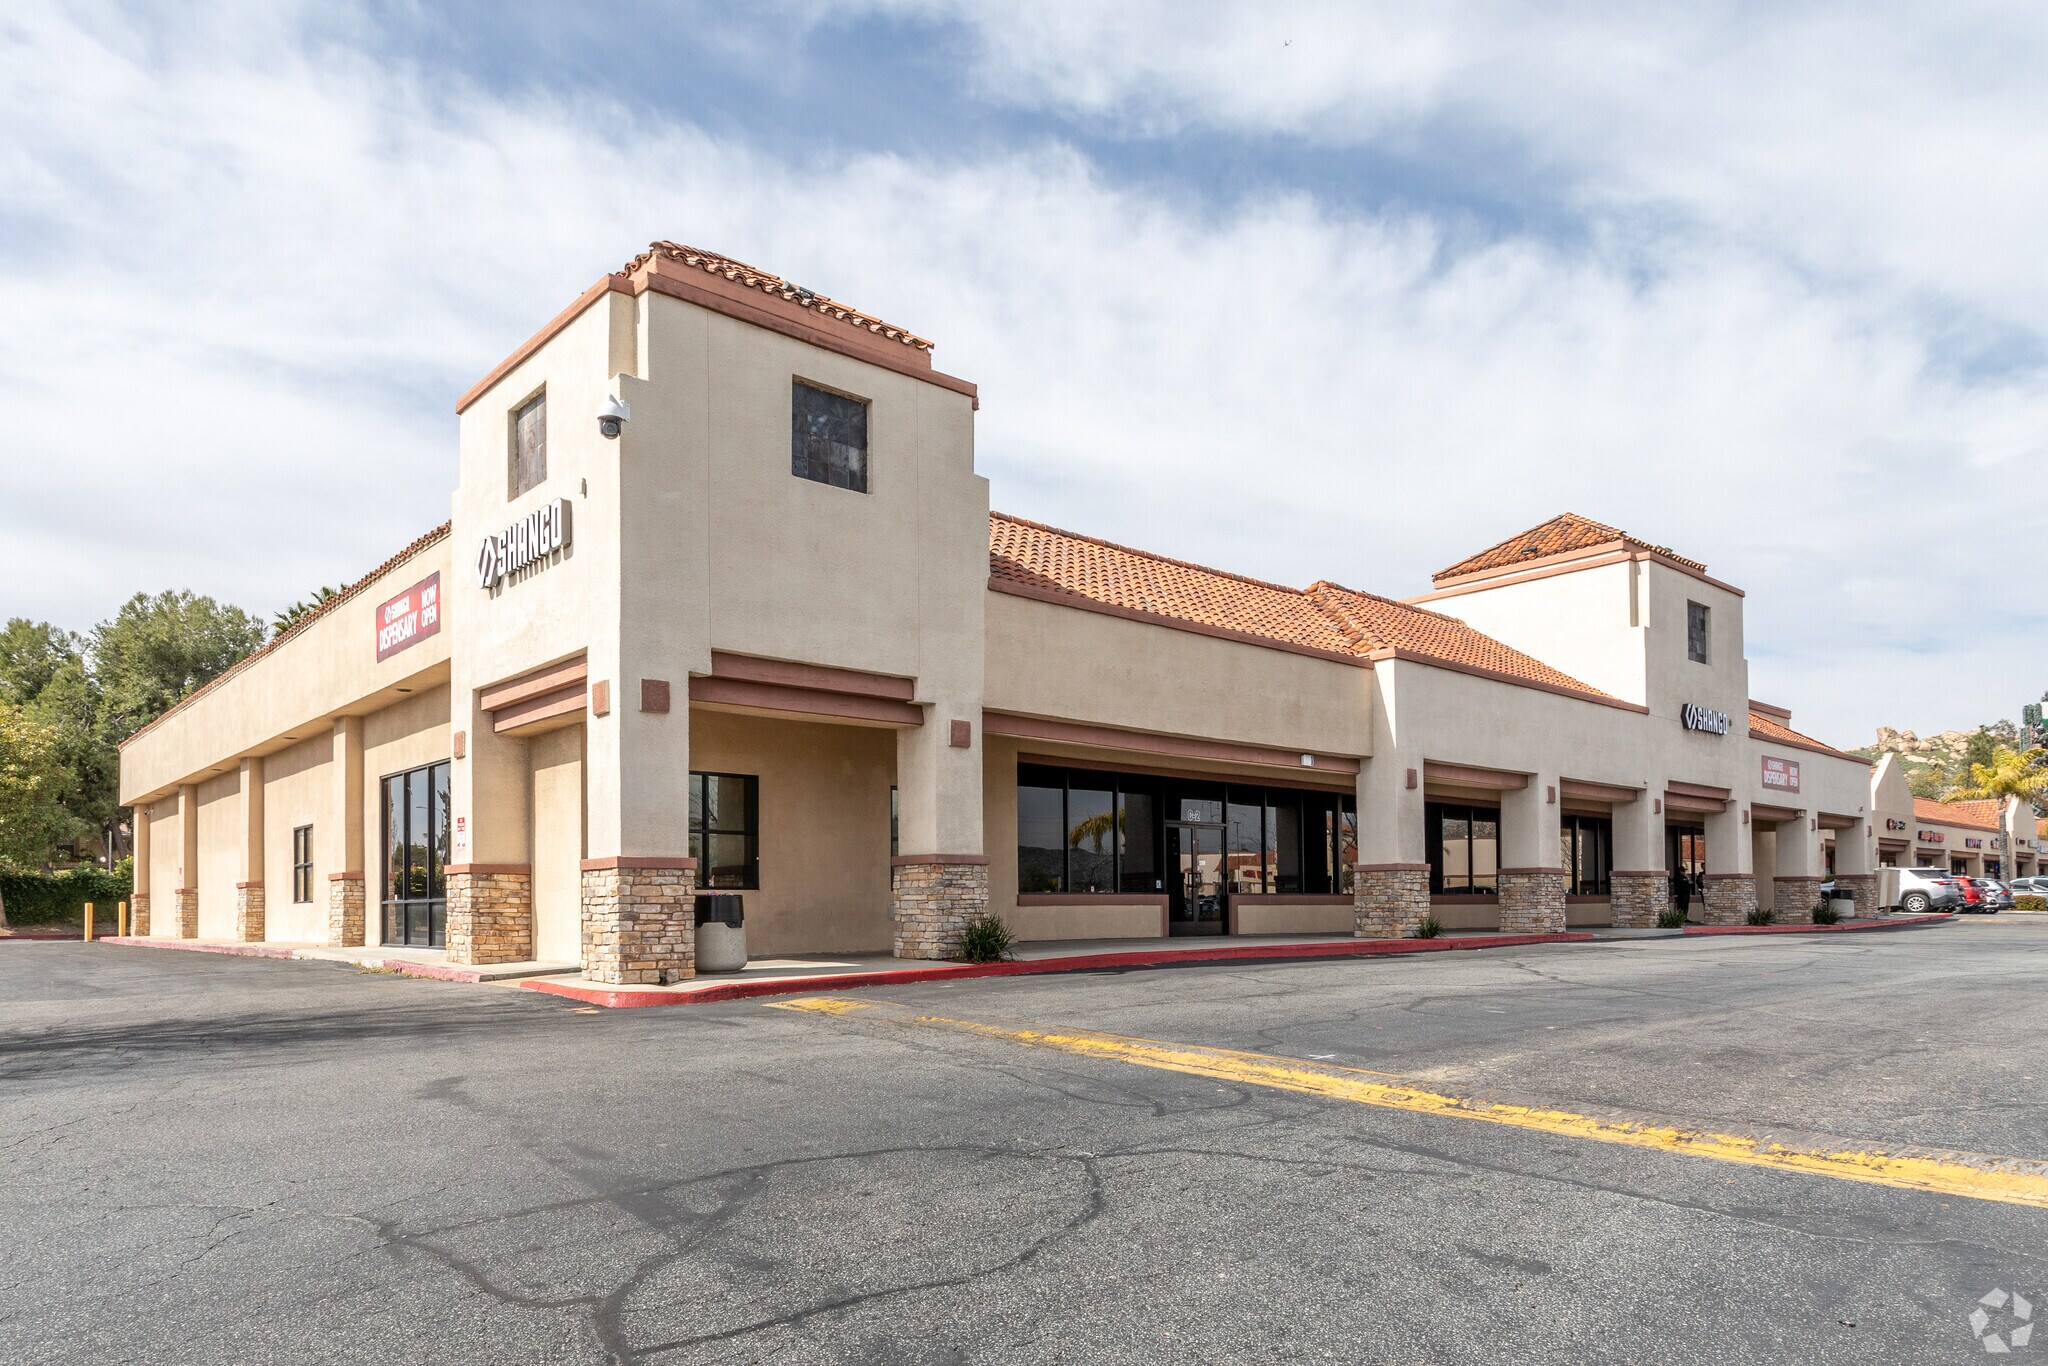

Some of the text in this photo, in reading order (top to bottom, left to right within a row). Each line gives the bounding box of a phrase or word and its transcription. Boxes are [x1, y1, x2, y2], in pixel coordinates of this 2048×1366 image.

[497, 497, 564, 577] SHANGO
[421, 584, 437, 608] NOW
[421, 603, 437, 628] OPEN
[379, 610, 418, 652] DISPENSARY
[1697, 707, 1728, 735] SHANGO
[1764, 770, 1787, 786] DISPENSARY
